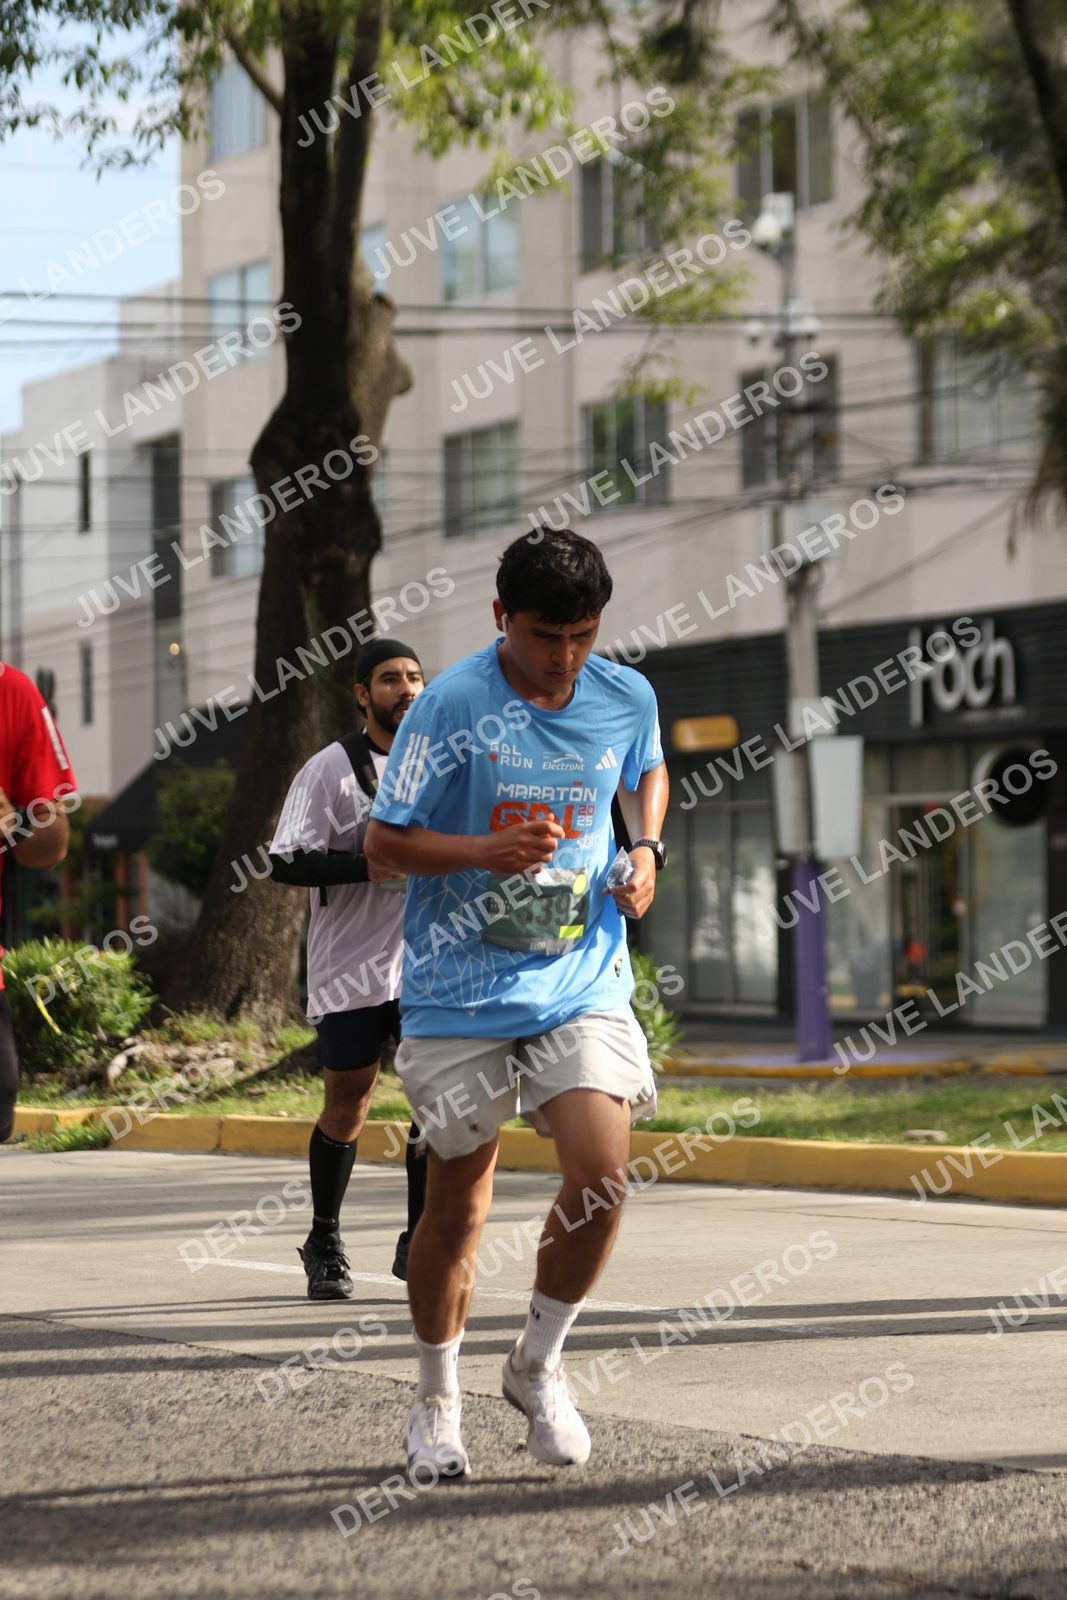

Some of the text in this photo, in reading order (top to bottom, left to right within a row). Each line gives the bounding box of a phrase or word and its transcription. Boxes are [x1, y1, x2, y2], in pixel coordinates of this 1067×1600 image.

[489, 741, 522, 755] GDL
[500, 756, 533, 769] RUN
[542, 761, 585, 771] Electrolit
[577, 804, 595, 816] 20
[576, 815, 593, 827] 25
